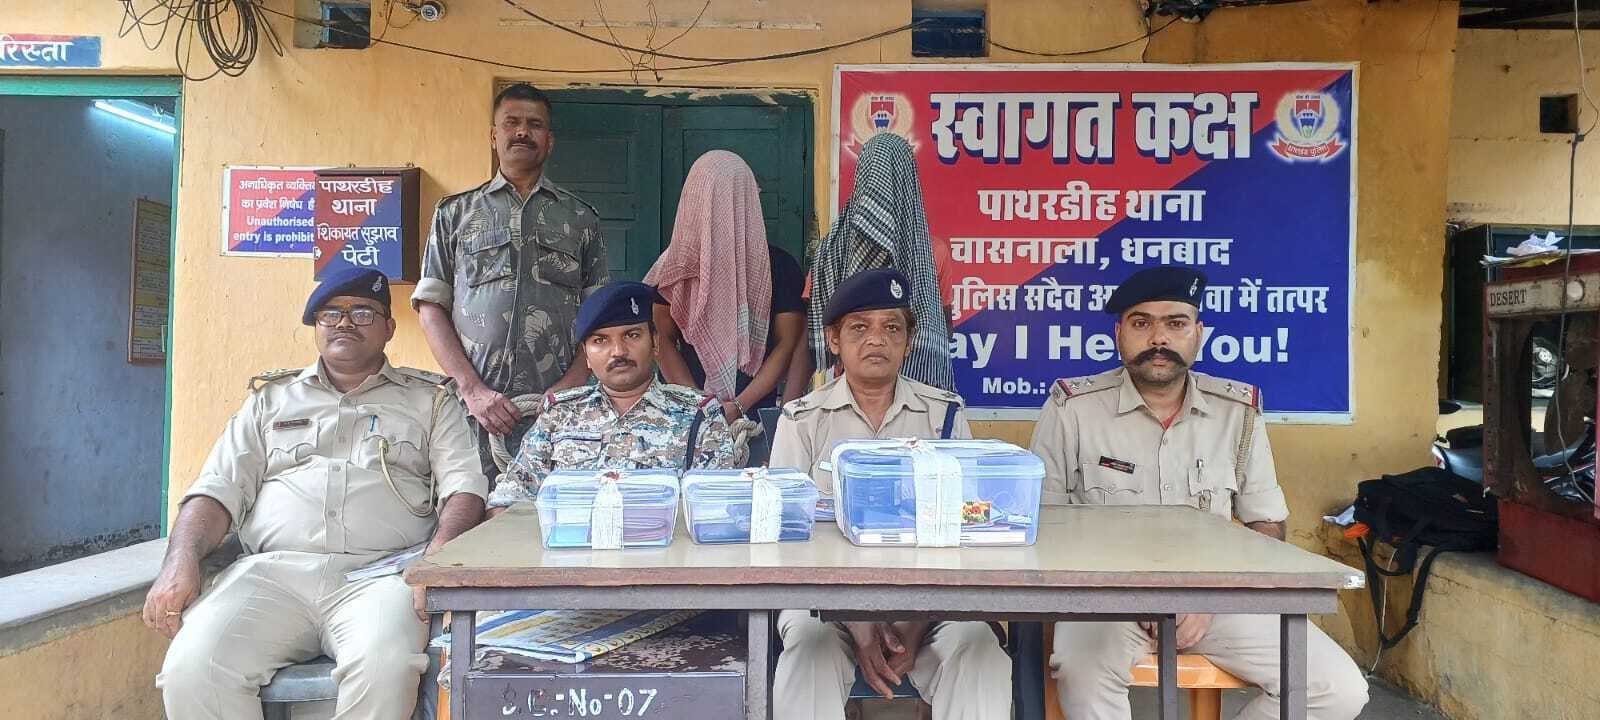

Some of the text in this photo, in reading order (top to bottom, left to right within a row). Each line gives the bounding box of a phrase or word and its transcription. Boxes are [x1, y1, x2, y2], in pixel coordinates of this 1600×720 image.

[930, 92, 1259, 161] स्वागत कक्ष
[319, 177, 394, 194] पाथरडीह
[241, 198, 255, 209] का
[255, 196, 278, 210] प्रवेश
[279, 196, 304, 211] निषेध
[331, 198, 377, 216] थाना
[977, 180, 1206, 221] पाथरडीह थाना
[246, 216, 314, 227] Unauthorised
[233, 231, 315, 244] entry is prohibit
[317, 222, 400, 246] शिकायत सुझाव
[341, 245, 380, 266] पेटी
[950, 237, 1233, 270] चासनाला, धनबाद
[1024, 277, 1083, 311] सदैव
[1238, 278, 1263, 312] में
[1266, 286, 1329, 313] तत्पर
[1490, 289, 1527, 307] DESERT
[950, 332, 998, 369] ay
[1015, 325, 1028, 360] I
[982, 377, 1046, 395] Mob.:
